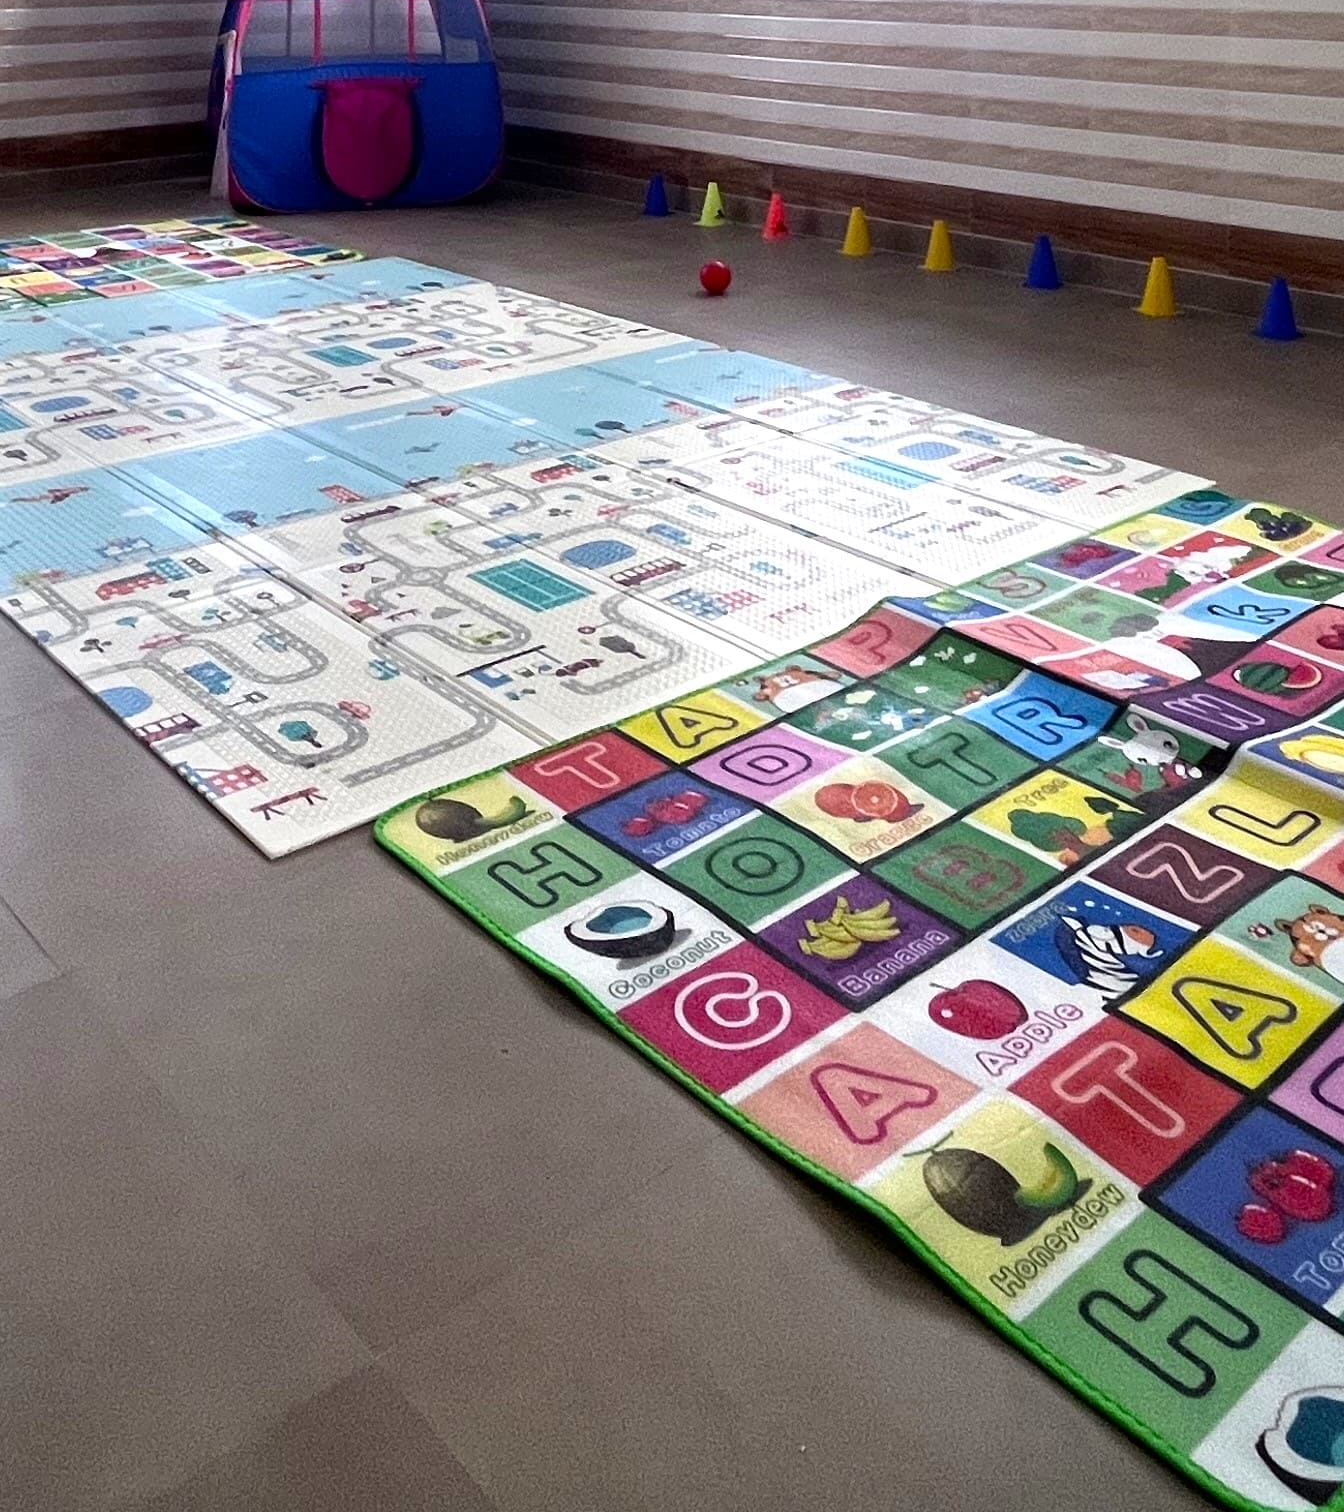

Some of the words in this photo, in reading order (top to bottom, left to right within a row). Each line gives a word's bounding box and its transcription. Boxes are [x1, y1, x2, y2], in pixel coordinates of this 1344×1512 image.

[1207, 604, 1290, 625] K
[656, 705, 739, 749] A
[992, 695, 1089, 746] R
[534, 741, 621, 789] T
[721, 744, 813, 785] D
[910, 733, 998, 787] T
[641, 805, 742, 860] Tomato
[1208, 804, 1321, 846] L
[487, 840, 603, 909] H
[705, 836, 805, 896] O
[911, 843, 1026, 911] B
[1126, 841, 1245, 903] Z
[608, 929, 734, 999] Coconut
[837, 927, 950, 998] Banana
[674, 971, 792, 1050] C
[976, 1001, 1083, 1078] Apple
[1172, 976, 1298, 1060] A
[810, 1062, 939, 1145] A
[1054, 1040, 1186, 1138] T
[989, 1182, 1126, 1299] Honeydew
[1078, 1248, 1261, 1398] H
